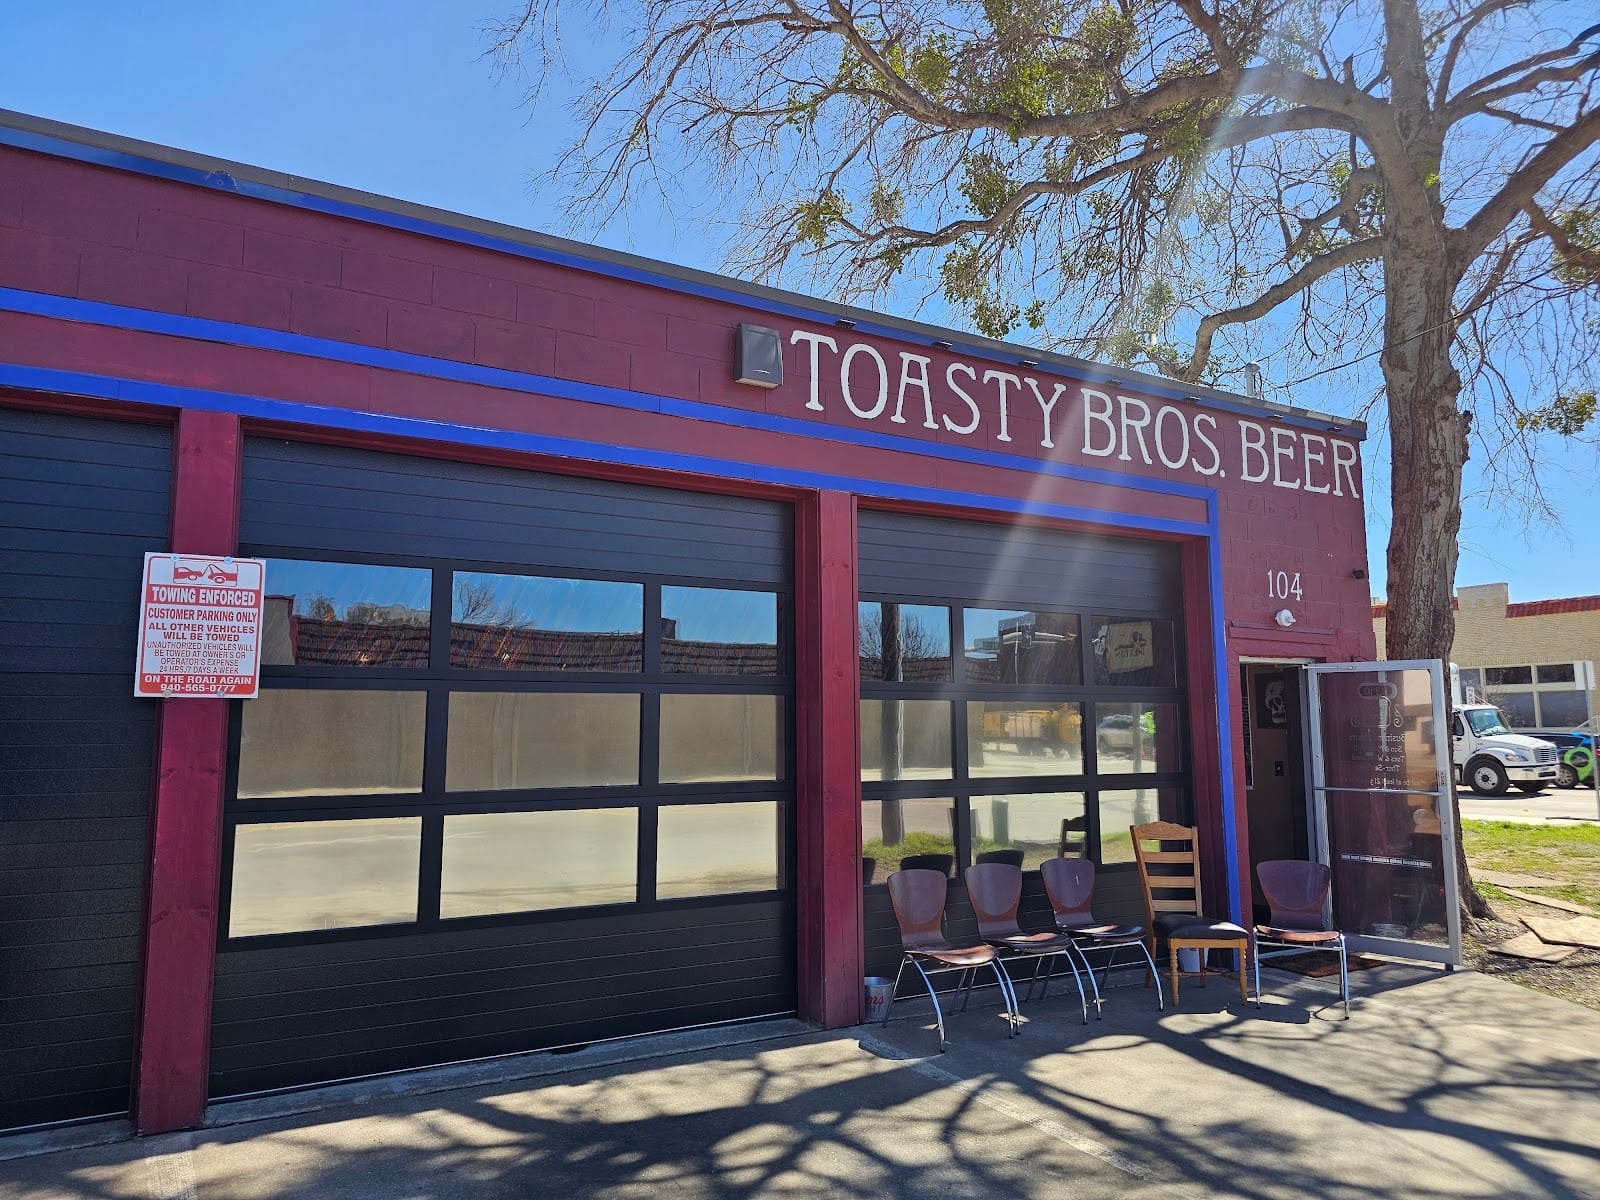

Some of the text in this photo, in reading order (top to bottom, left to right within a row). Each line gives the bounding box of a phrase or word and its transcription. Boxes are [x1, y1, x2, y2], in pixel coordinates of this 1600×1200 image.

[790, 329, 1361, 500] TOASTY BROS. BEER
[1267, 570, 1303, 601] 104
[152, 587, 255, 606] TOWING ENFORCED
[148, 608, 256, 622] CUSTOMER PARKING ONLY
[164, 632, 186, 640] WILL
[207, 625, 254, 633] VEHICLES
